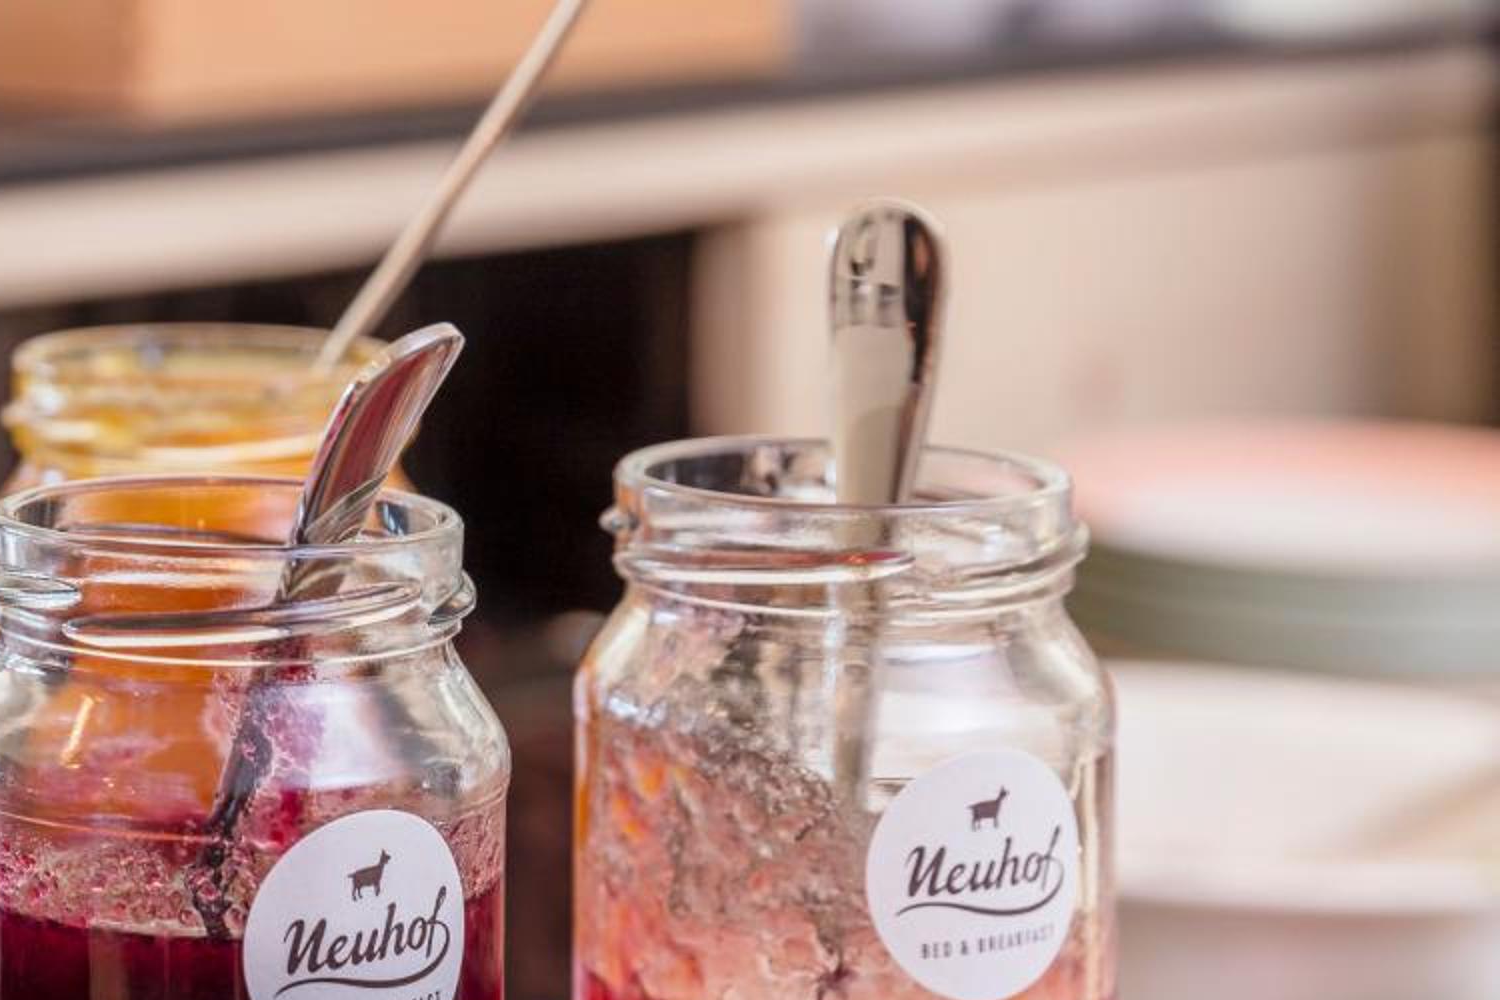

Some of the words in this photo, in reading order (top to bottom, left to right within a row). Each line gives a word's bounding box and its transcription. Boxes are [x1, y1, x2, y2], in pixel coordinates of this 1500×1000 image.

[904, 825, 1064, 897] Neuhof
[283, 885, 450, 976] Neuhof
[921, 941, 952, 960] BED
[960, 939, 969, 956] &
[979, 923, 1055, 954] BREAKFAST
